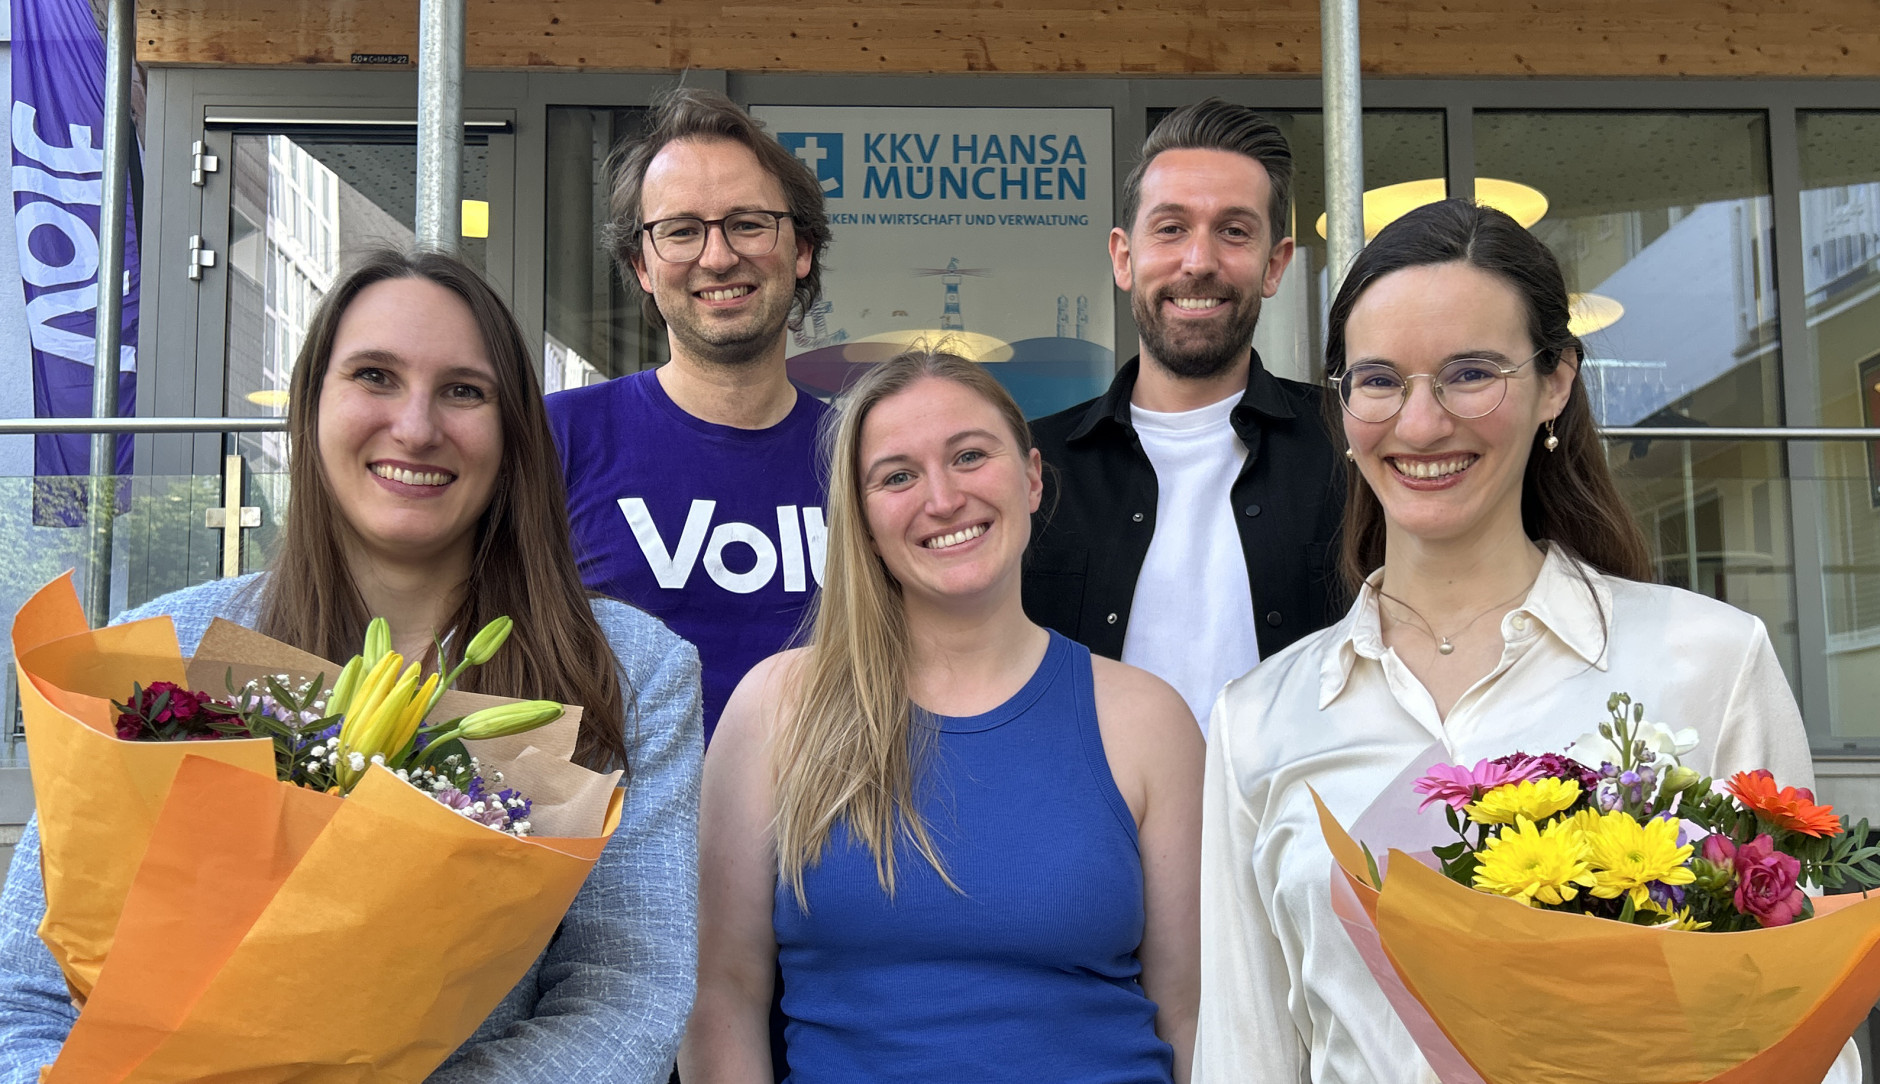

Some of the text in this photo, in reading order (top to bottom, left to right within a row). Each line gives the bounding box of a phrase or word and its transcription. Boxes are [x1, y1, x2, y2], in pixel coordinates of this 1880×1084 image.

[863, 133, 1087, 165] KKV HANSA
[862, 166, 1087, 200] MÜNCHEN
[861, 213, 876, 225] IN
[878, 213, 962, 226] WIRTSCHAFT
[965, 214, 996, 226] UND
[998, 214, 1089, 226] VERWALTUNG
